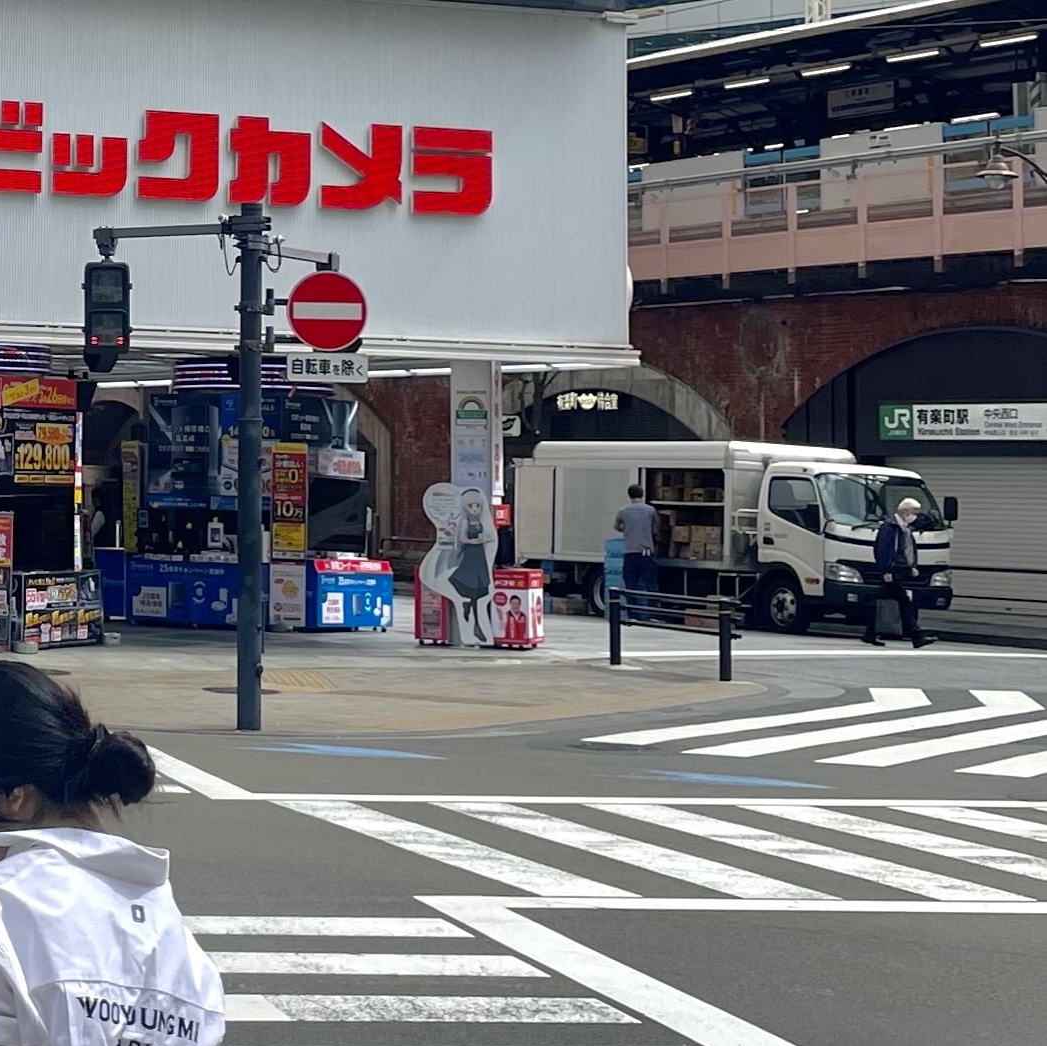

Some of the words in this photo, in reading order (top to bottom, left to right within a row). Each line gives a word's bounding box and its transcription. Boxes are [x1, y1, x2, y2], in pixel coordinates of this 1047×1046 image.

[291, 358, 363, 376] 自転車を除く
[884, 408, 911, 429] JR
[916, 409, 969, 425] 有楽町駅
[984, 408, 1018, 420] 中央西口
